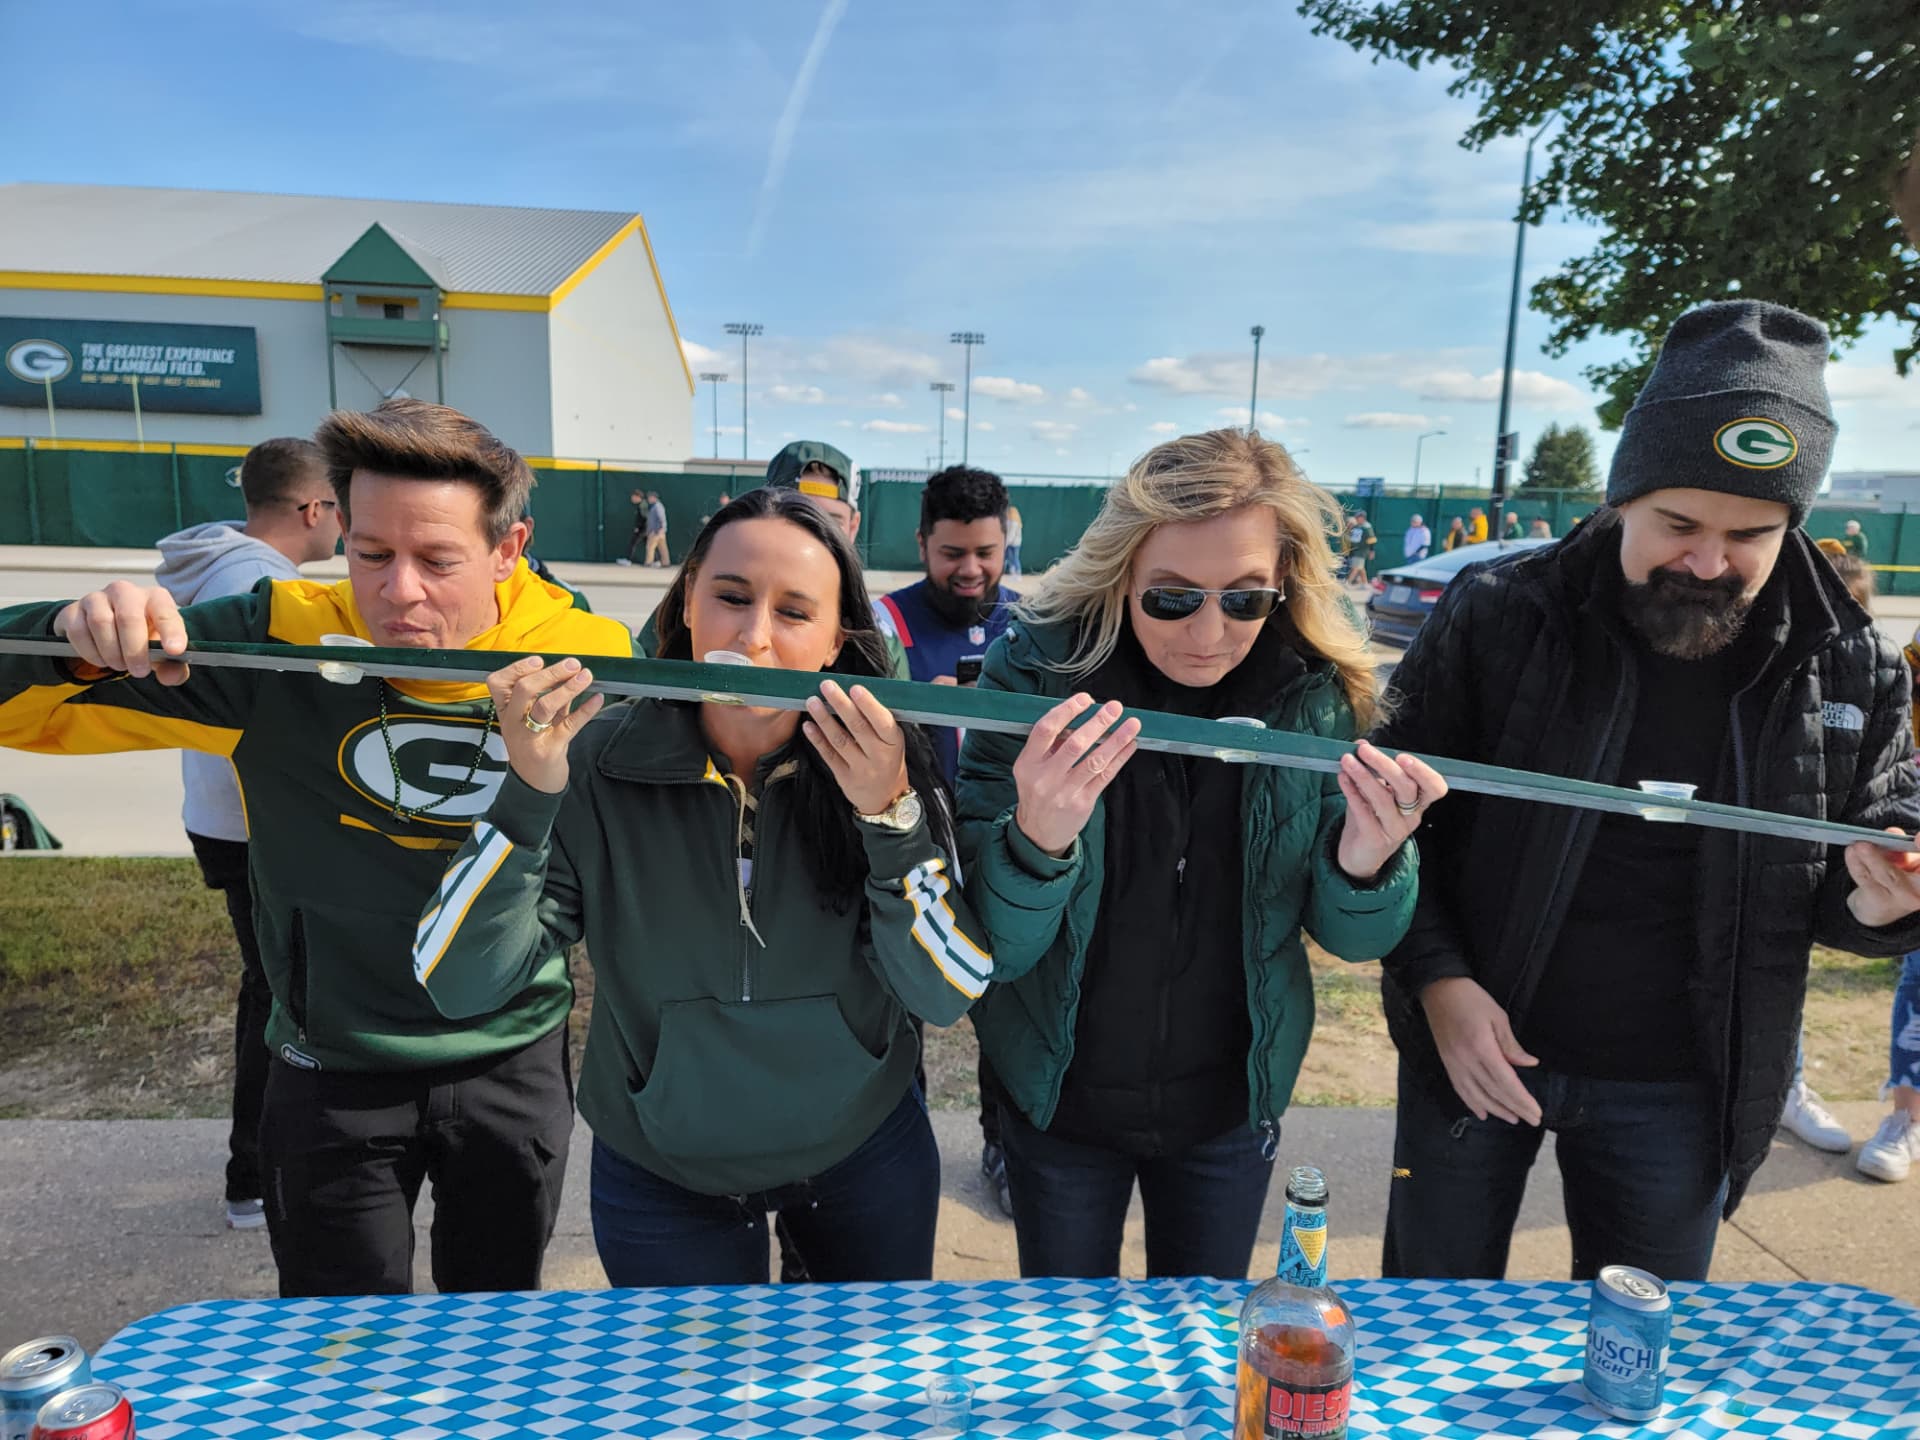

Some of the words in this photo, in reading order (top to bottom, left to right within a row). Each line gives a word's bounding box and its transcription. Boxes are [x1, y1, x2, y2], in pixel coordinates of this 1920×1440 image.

[81, 343, 104, 358] THE
[105, 344, 164, 361] GREATEST
[165, 346, 236, 364] EXPERIENCE
[82, 357, 95, 372] IS
[96, 358, 112, 373] AT
[113, 359, 168, 375] LAMBEAU
[1720, 421, 1793, 465] G
[353, 722, 511, 816] G
[1591, 1351, 1637, 1377] LIGHT
[1269, 1381, 1352, 1422] DIES
